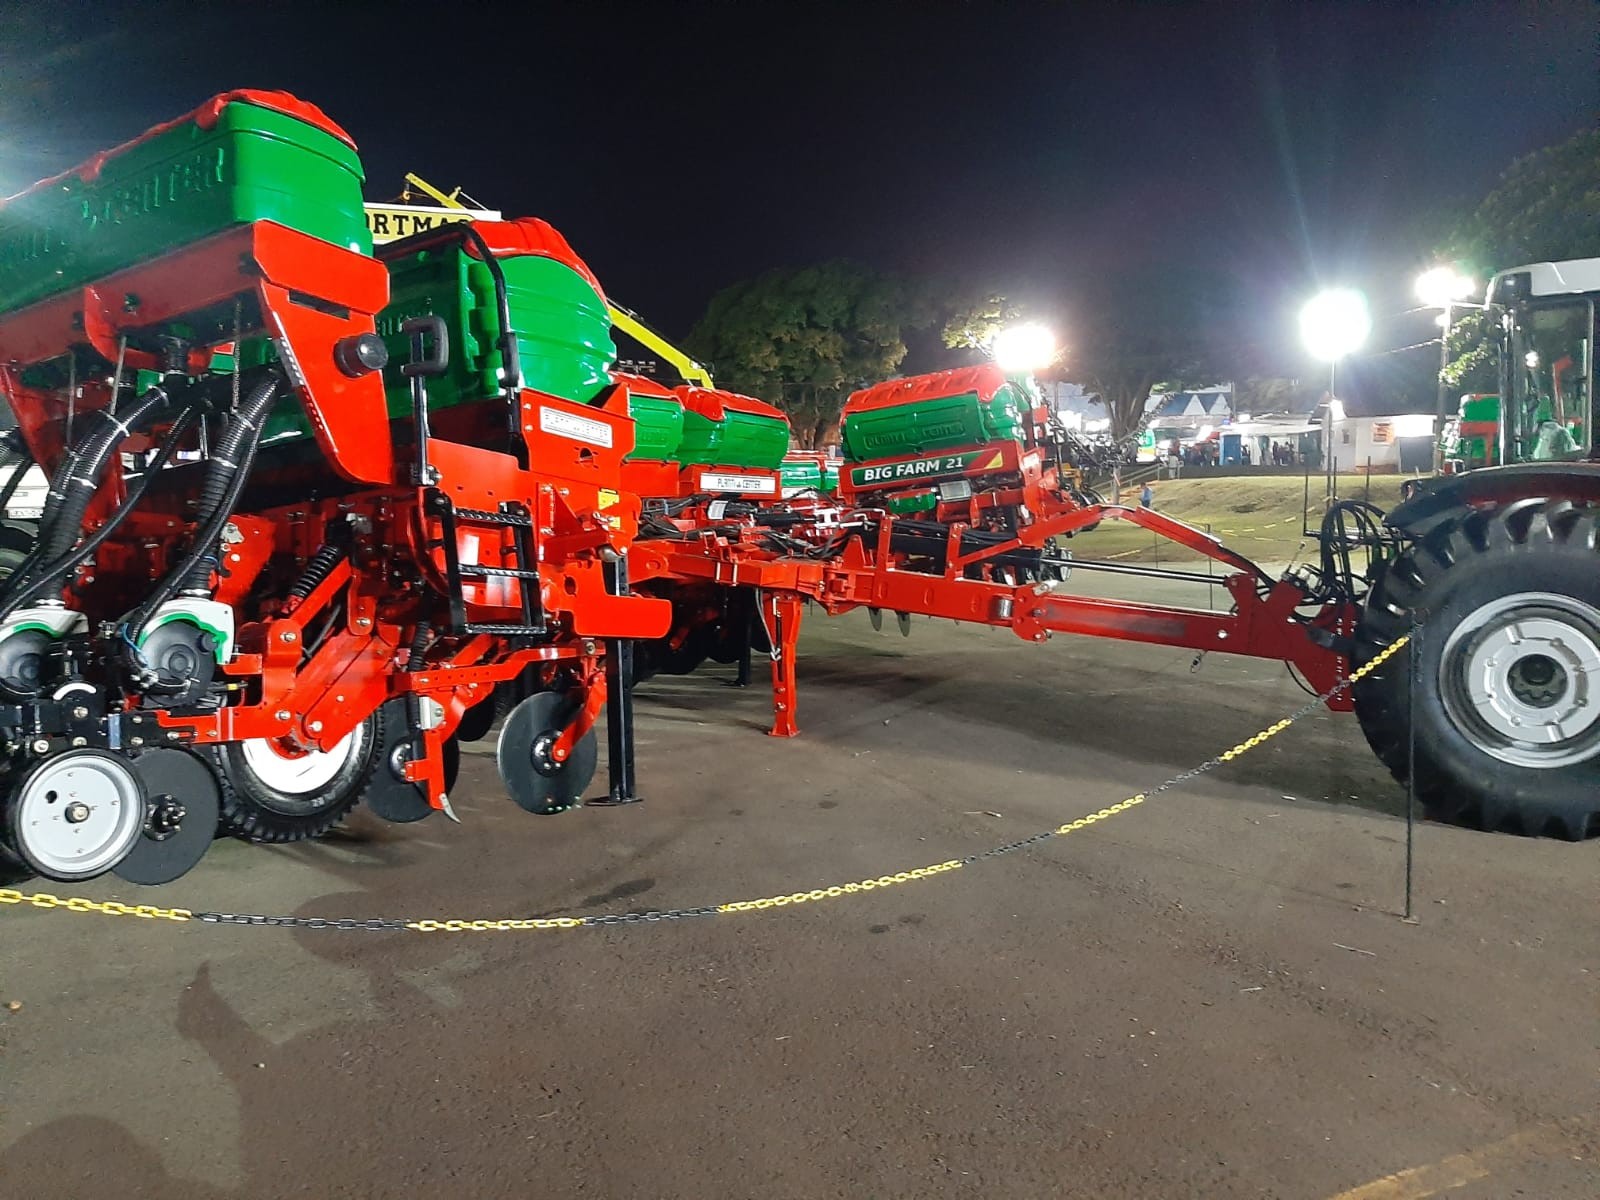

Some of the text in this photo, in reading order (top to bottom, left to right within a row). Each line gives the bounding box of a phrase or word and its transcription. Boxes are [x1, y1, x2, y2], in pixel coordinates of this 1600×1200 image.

[364, 213, 469, 236] RTM
[864, 457, 964, 481] BIG FARM 21
